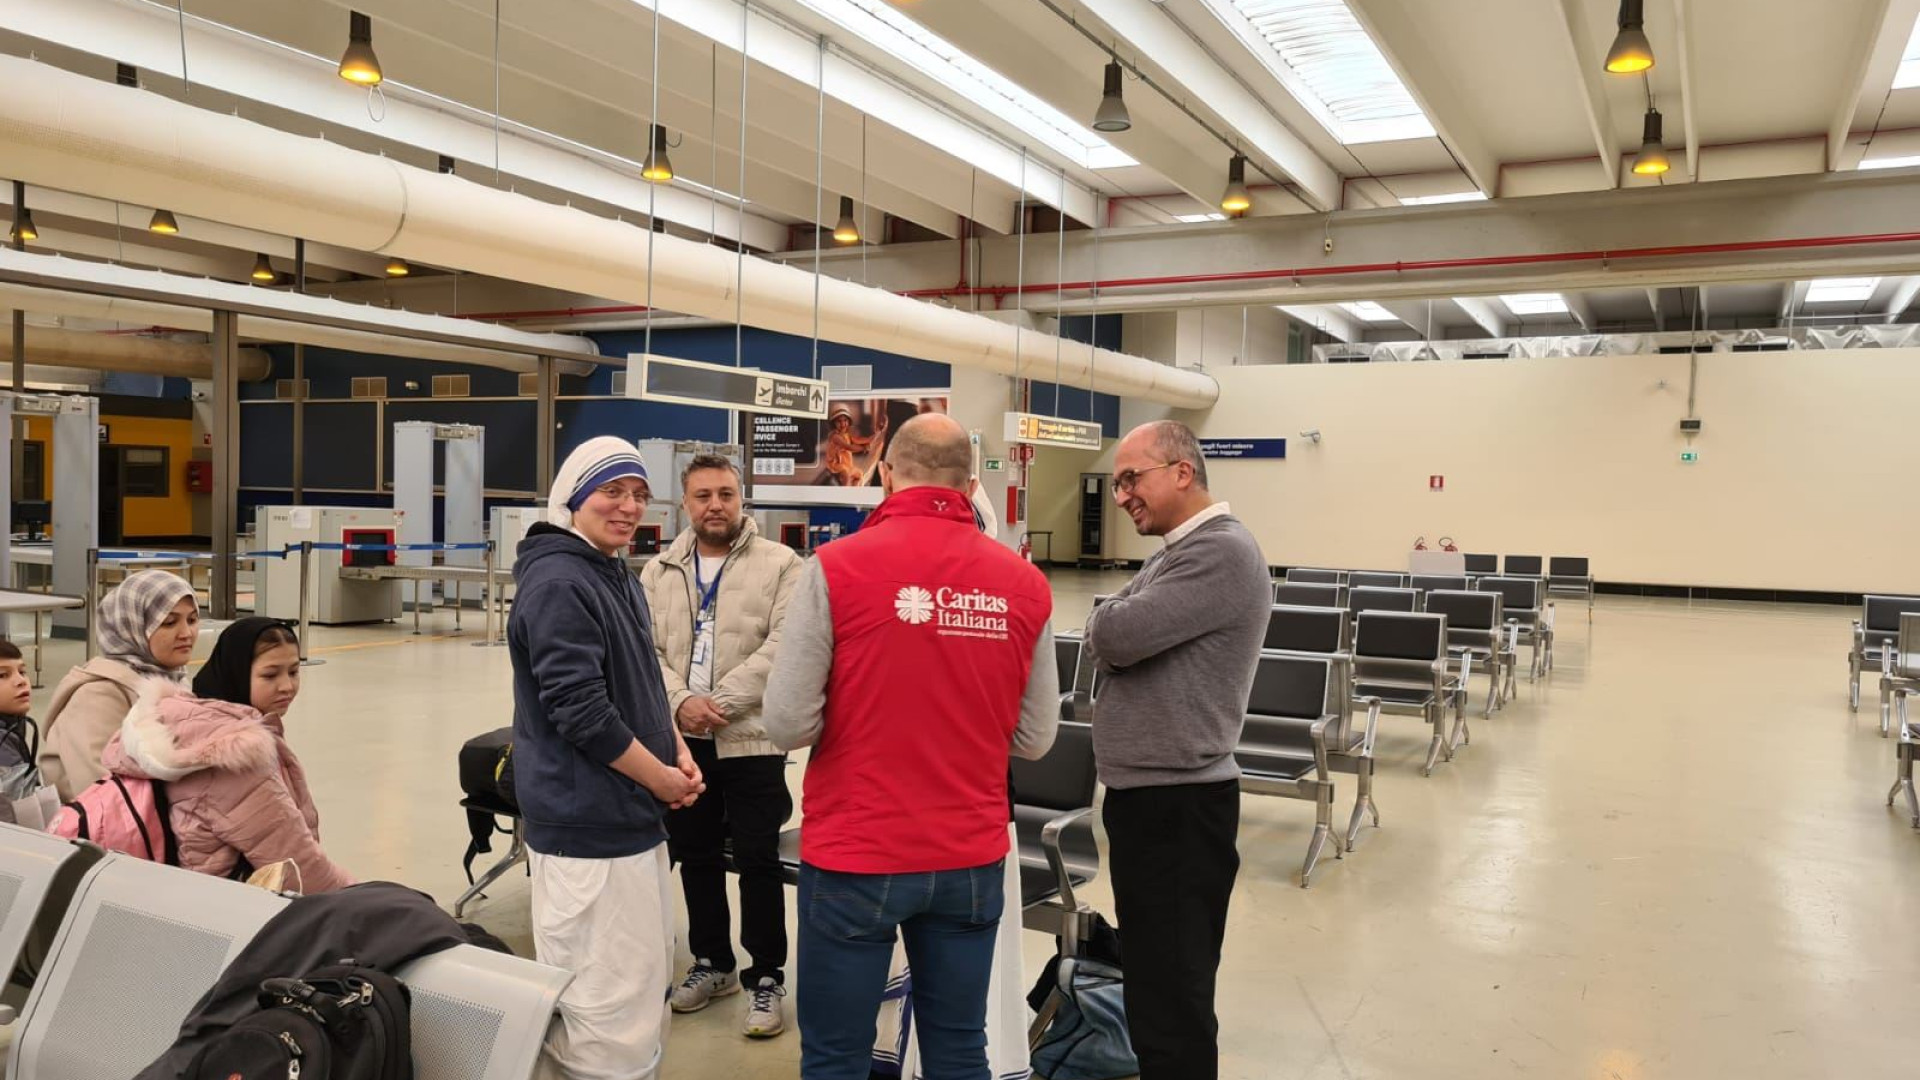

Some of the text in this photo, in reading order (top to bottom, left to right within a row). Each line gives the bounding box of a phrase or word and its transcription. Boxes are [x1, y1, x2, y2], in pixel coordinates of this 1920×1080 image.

[754, 416, 792, 424] CELLENCE
[756, 425, 799, 433] PASSENGER
[754, 433, 776, 441] RVICE
[936, 586, 1008, 613] Caritas
[936, 609, 1008, 631] Italiana
